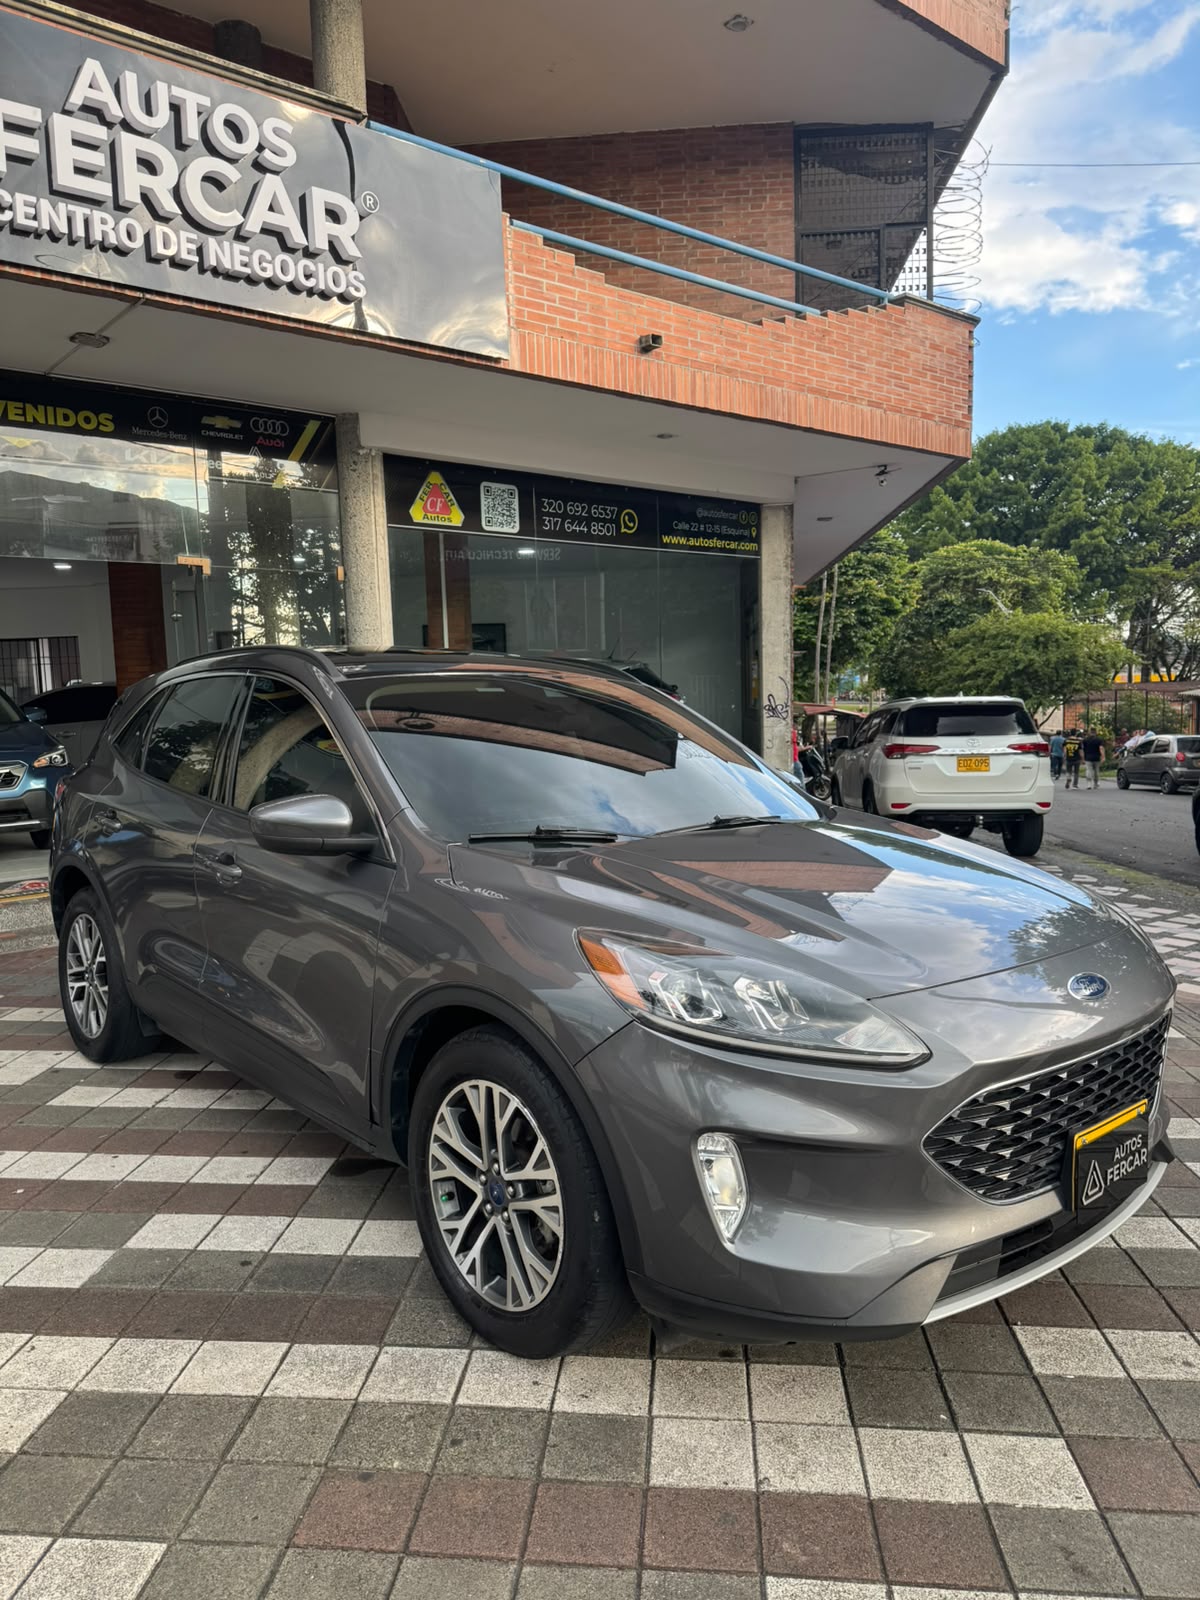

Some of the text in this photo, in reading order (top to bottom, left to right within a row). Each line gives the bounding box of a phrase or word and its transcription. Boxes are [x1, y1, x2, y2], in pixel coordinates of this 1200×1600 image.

[64, 57, 298, 172] AUTOS
[0, 98, 362, 262] FERCAR
[151, 224, 199, 266] DE
[204, 237, 367, 301] NEGOCIOS
[131, 426, 188, 441] Mercedes-Benz
[201, 429, 244, 440] CHEVROLET
[256, 436, 285, 448] Audi
[418, 481, 433, 502] FER
[426, 496, 445, 513] CF
[541, 498, 618, 519] 320 692 6537
[422, 513, 453, 523] Autos
[542, 516, 616, 536] 317 644 8501
[672, 520, 690, 531] Calle
[690, 522, 699, 532] 22
[662, 534, 758, 551] www.autosfercar.com
[1113, 1134, 1142, 1162] AUTOS
[1107, 1148, 1147, 1186] FERCAR
